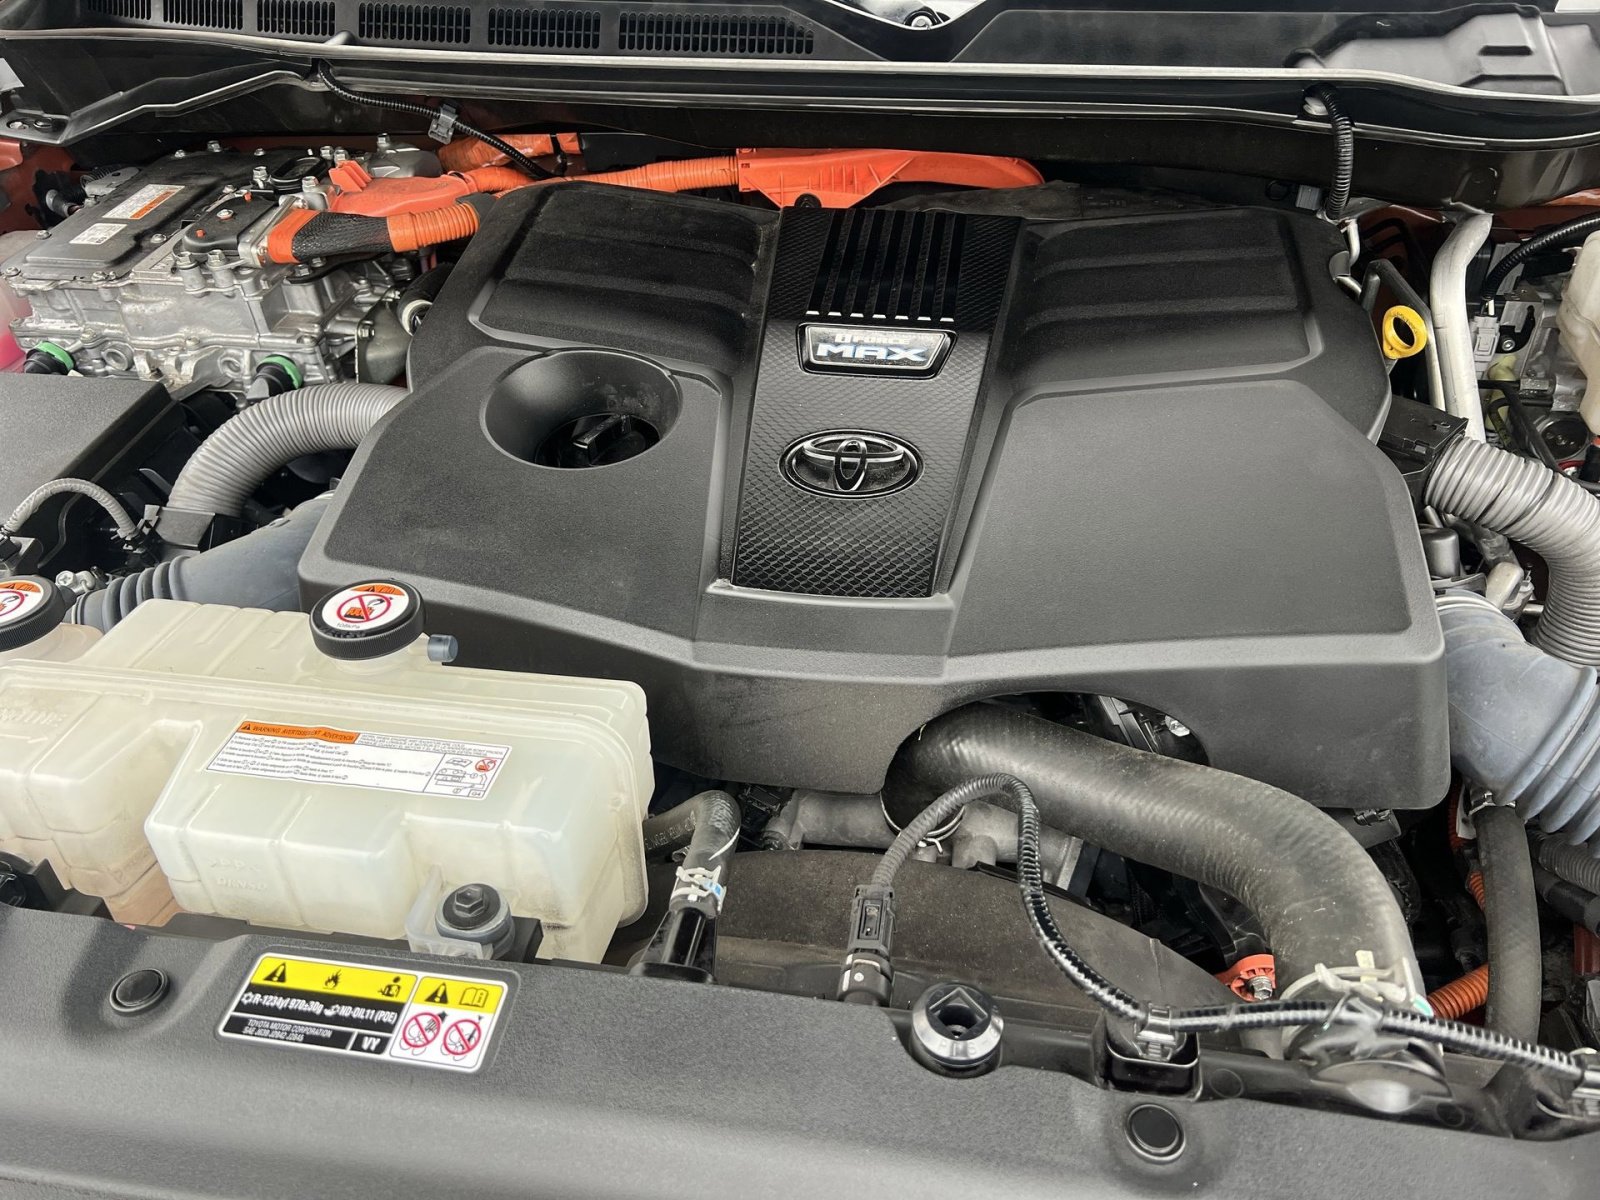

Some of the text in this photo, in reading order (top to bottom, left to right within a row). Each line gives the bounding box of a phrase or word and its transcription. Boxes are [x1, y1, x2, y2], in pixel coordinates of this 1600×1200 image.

[816, 343, 928, 362] MAX
[269, 1021, 292, 1032] MOTOR
[362, 1036, 381, 1051] VY
